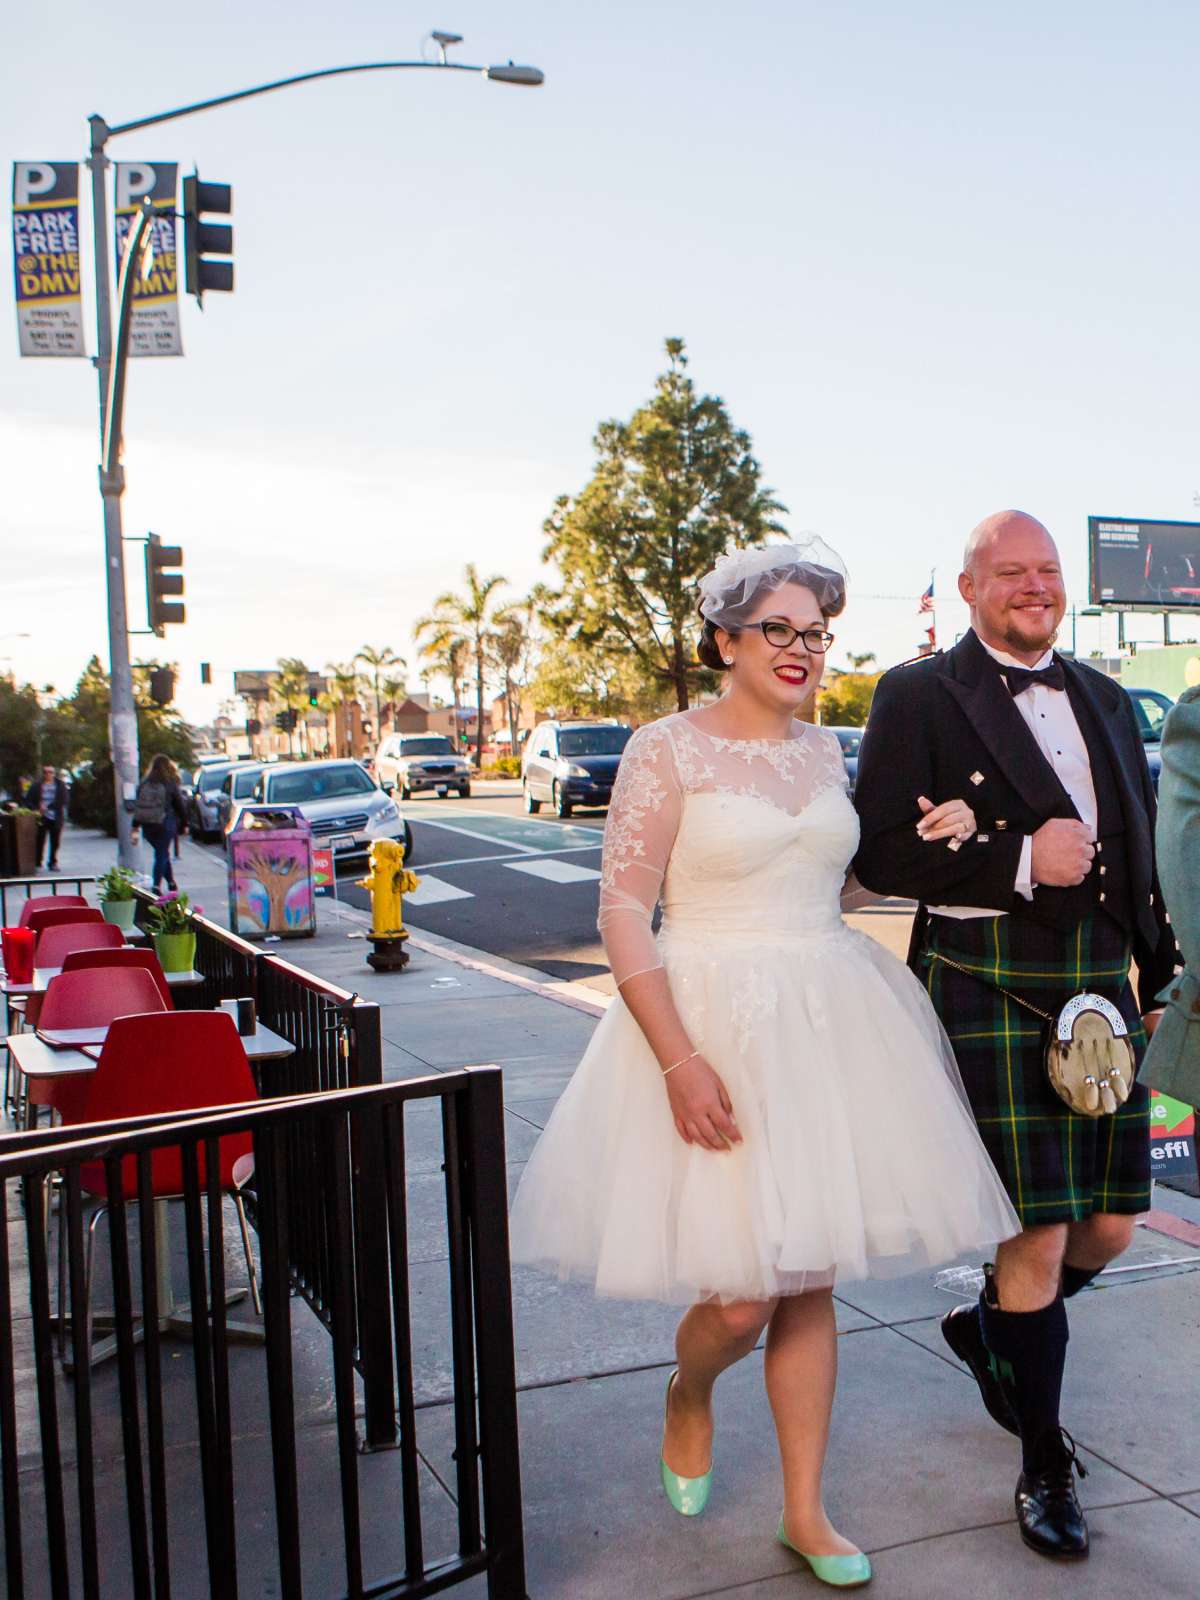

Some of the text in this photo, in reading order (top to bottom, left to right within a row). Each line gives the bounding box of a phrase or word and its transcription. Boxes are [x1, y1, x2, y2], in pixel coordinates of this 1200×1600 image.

[15, 163, 56, 206] P
[117, 163, 157, 209] P
[14, 212, 74, 234] PARK
[16, 232, 78, 255] FREE
[18, 252, 79, 274] @THE
[21, 271, 80, 296] DMV
